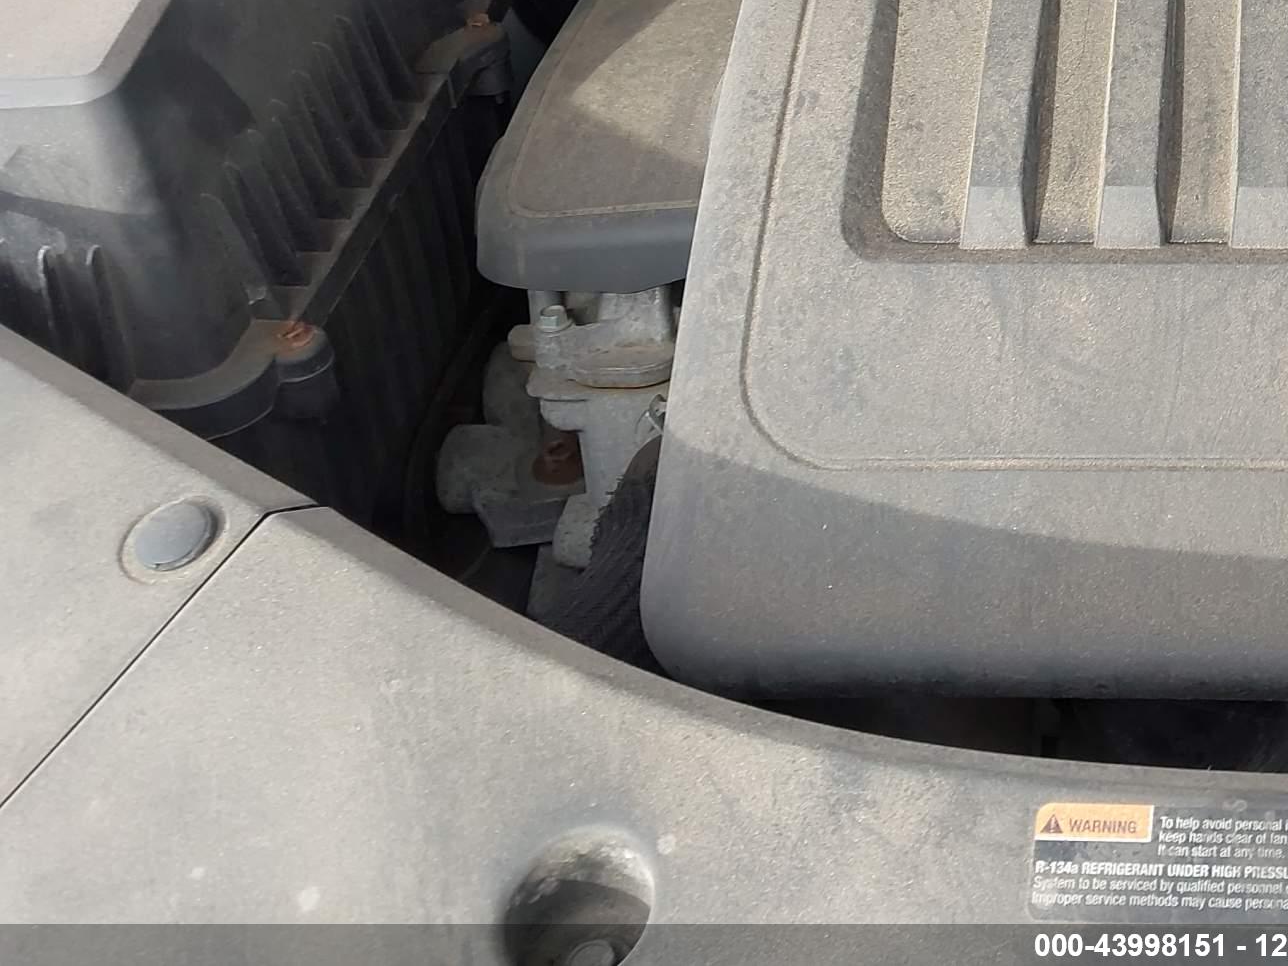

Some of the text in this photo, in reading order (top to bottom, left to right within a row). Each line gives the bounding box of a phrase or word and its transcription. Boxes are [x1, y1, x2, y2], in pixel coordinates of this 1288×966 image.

[1068, 818, 1137, 834] WARNING
[1160, 816, 1174, 829] To
[1176, 817, 1200, 831] help
[1202, 818, 1232, 830] avoid
[1235, 819, 1282, 833] personal
[1189, 832, 1223, 844] hands
[1225, 832, 1252, 844] clear
[1256, 833, 1266, 844] of
[1168, 846, 1189, 856] can
[1192, 846, 1218, 856] start
[1220, 846, 1231, 858] at
[1234, 848, 1254, 859] any
[1035, 860, 1078, 874] R-134a
[1082, 862, 1165, 876] REFRIGERANT
[1167, 864, 1210, 877] UNDER
[1212, 865, 1240, 878] HIGH
[1033, 876, 1075, 890] System
[1078, 877, 1089, 890] to
[1092, 878, 1107, 890] be
[1110, 879, 1156, 891] serviced
[1160, 879, 1174, 894] by
[1176, 880, 1225, 894] qualified
[1227, 882, 1284, 894] personnel
[1032, 892, 1083, 906] Improper
[1085, 894, 1126, 905] service
[1128, 894, 1178, 906] methods
[1181, 897, 1206, 910] may
[1208, 897, 1242, 908] cause
